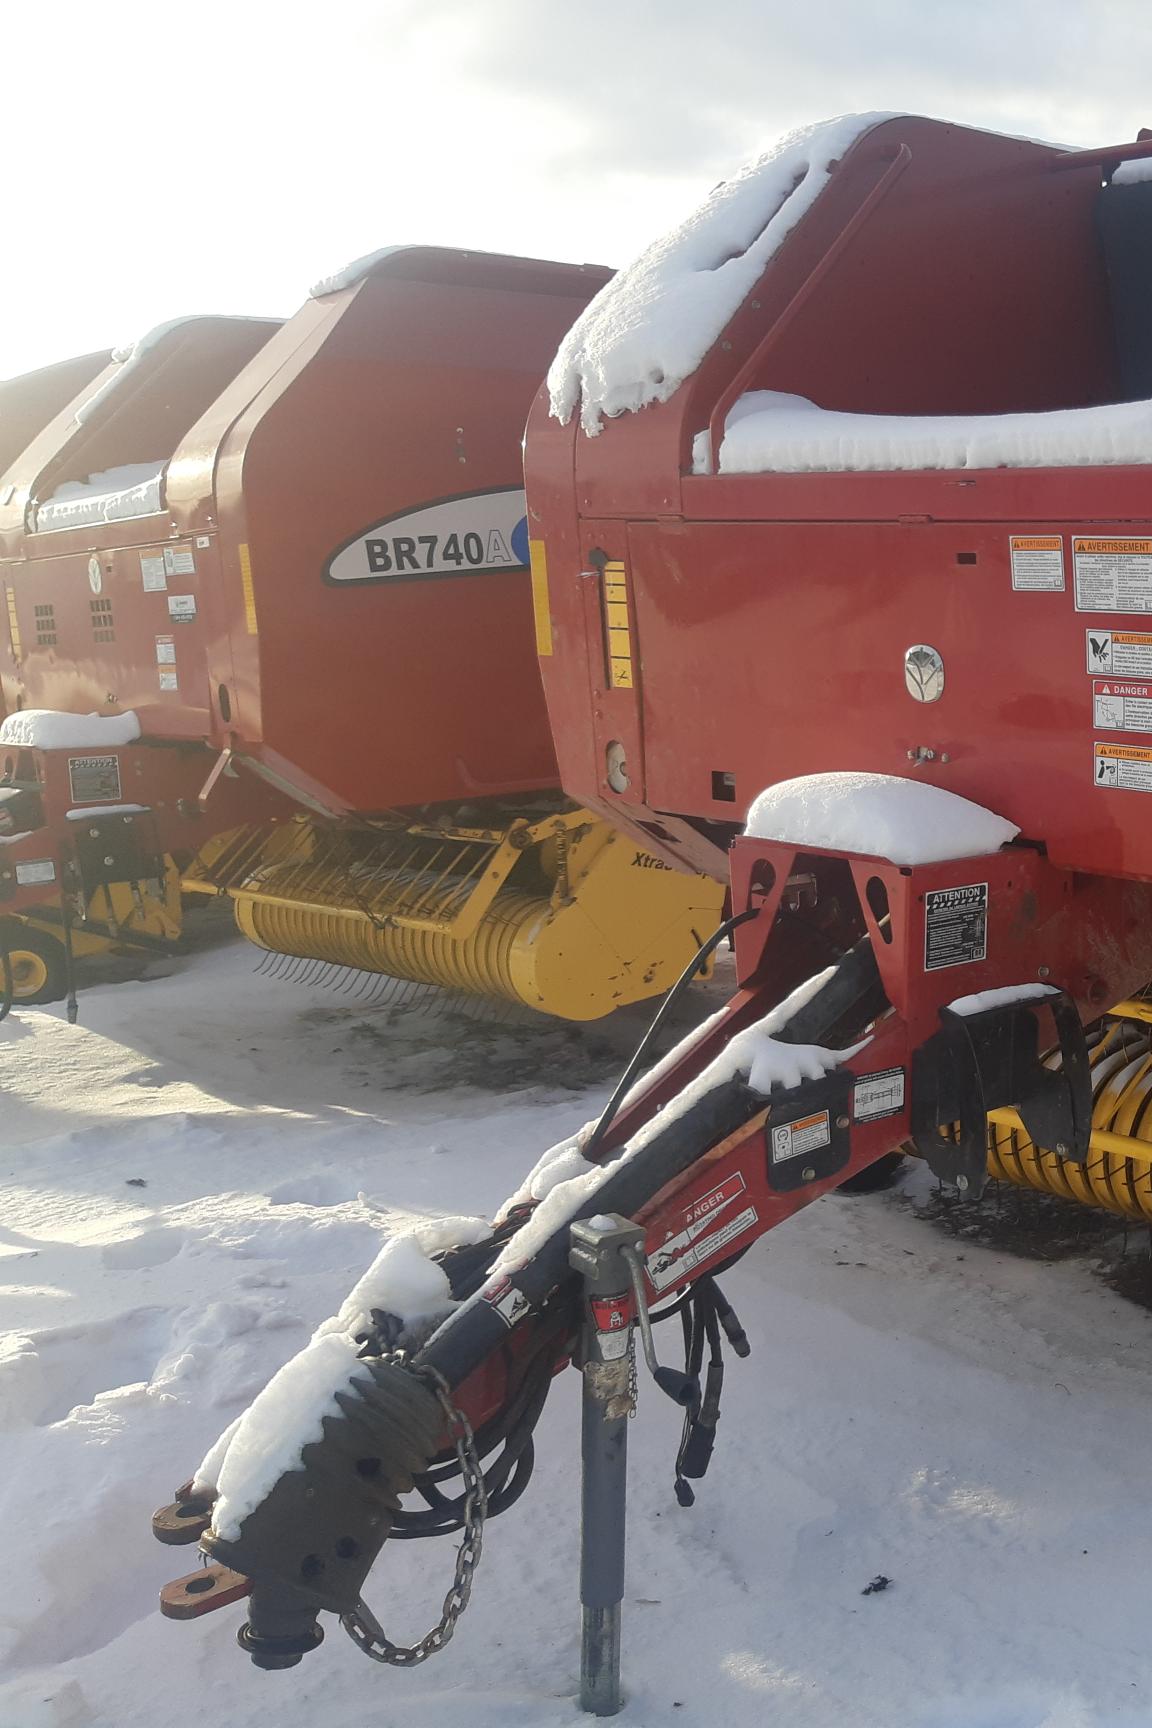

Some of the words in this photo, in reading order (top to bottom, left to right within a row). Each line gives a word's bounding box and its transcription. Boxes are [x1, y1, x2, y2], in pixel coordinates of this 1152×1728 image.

[365, 530, 511, 572] BR740A
[1087, 541, 1150, 552] AVERTISSEMENT
[1114, 685, 1148, 696] DANGER
[1108, 748, 1151, 759] AVERTISSEMENT
[933, 887, 980, 903] ATTENTION
[686, 1191, 725, 1223] ANGER
